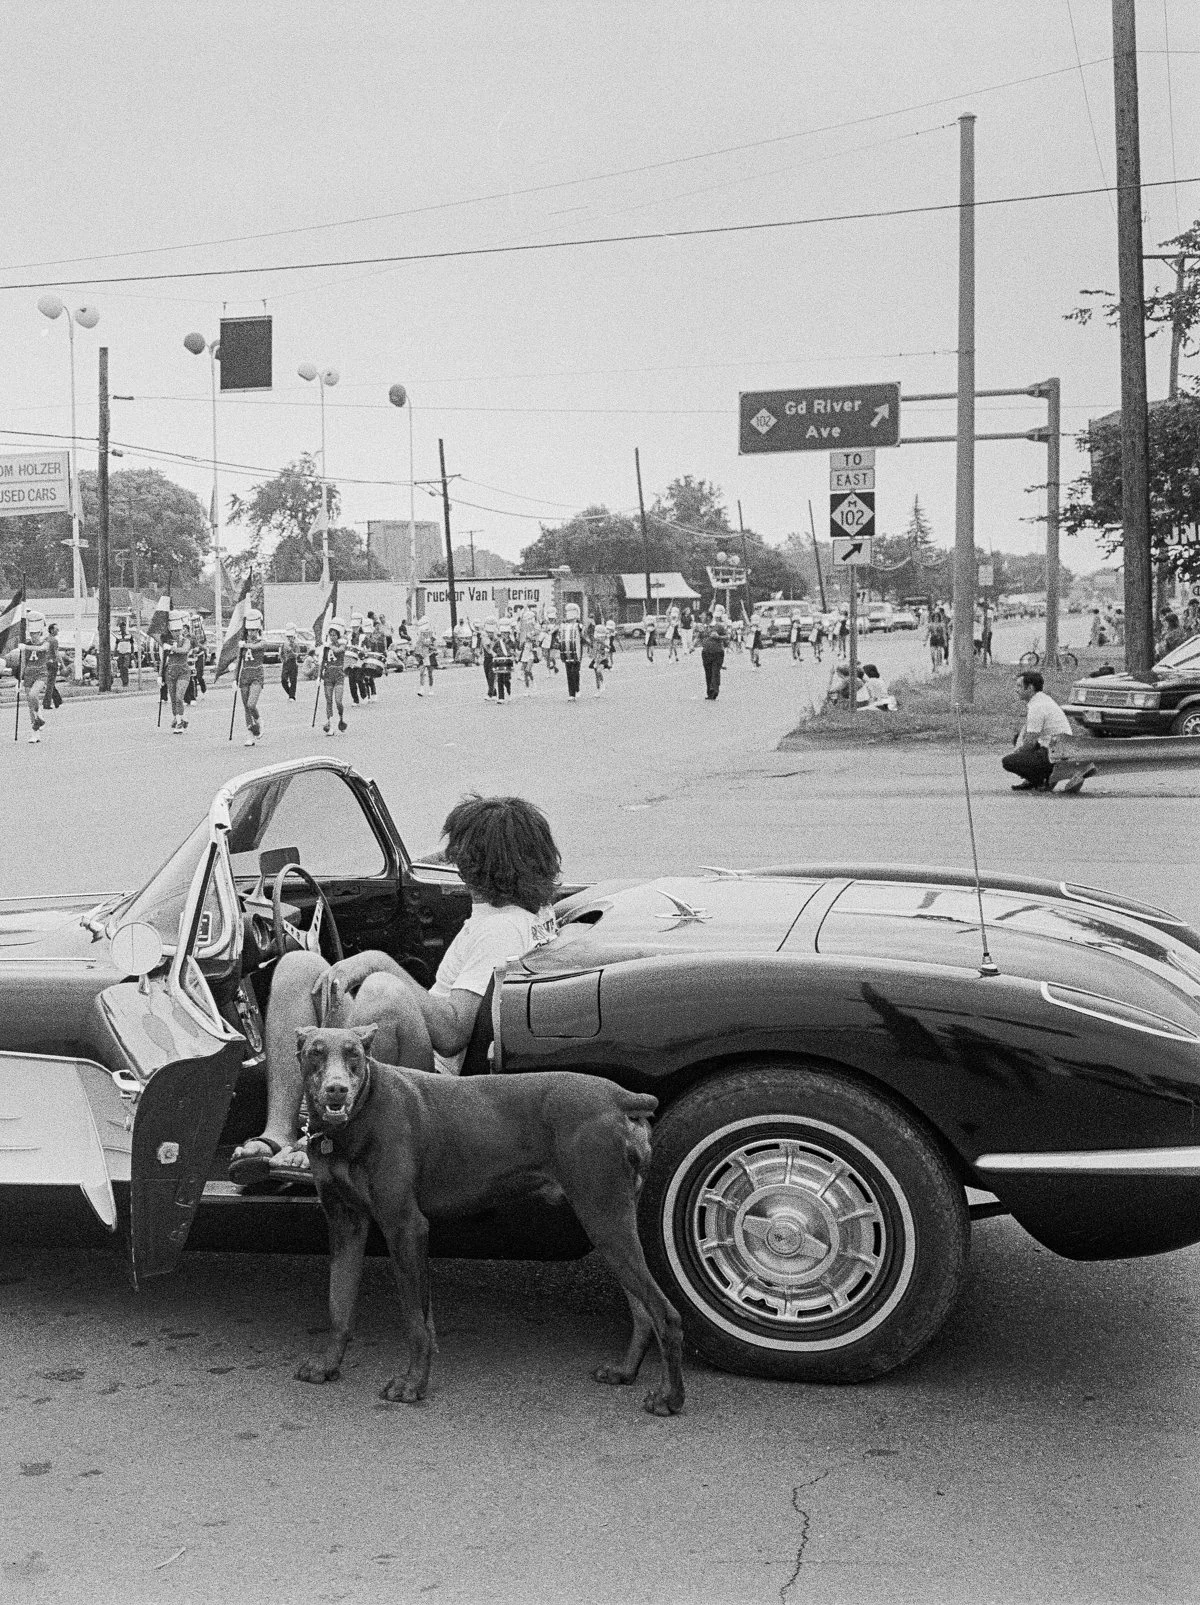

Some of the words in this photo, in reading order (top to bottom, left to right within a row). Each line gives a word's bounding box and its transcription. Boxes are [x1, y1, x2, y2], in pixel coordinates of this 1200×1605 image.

[785, 401, 806, 415] Gd
[814, 399, 862, 414] River
[806, 425, 841, 438] Ave
[844, 453, 862, 466] TO
[18, 462, 61, 476] HOLZER
[836, 473, 868, 486] EAST
[28, 487, 57, 501] CARS
[848, 500, 857, 508] M
[840, 510, 865, 526] 102
[468, 587, 487, 601] Van
[29, 651, 38, 661] A
[244, 649, 254, 661] A
[327, 649, 337, 662] A
